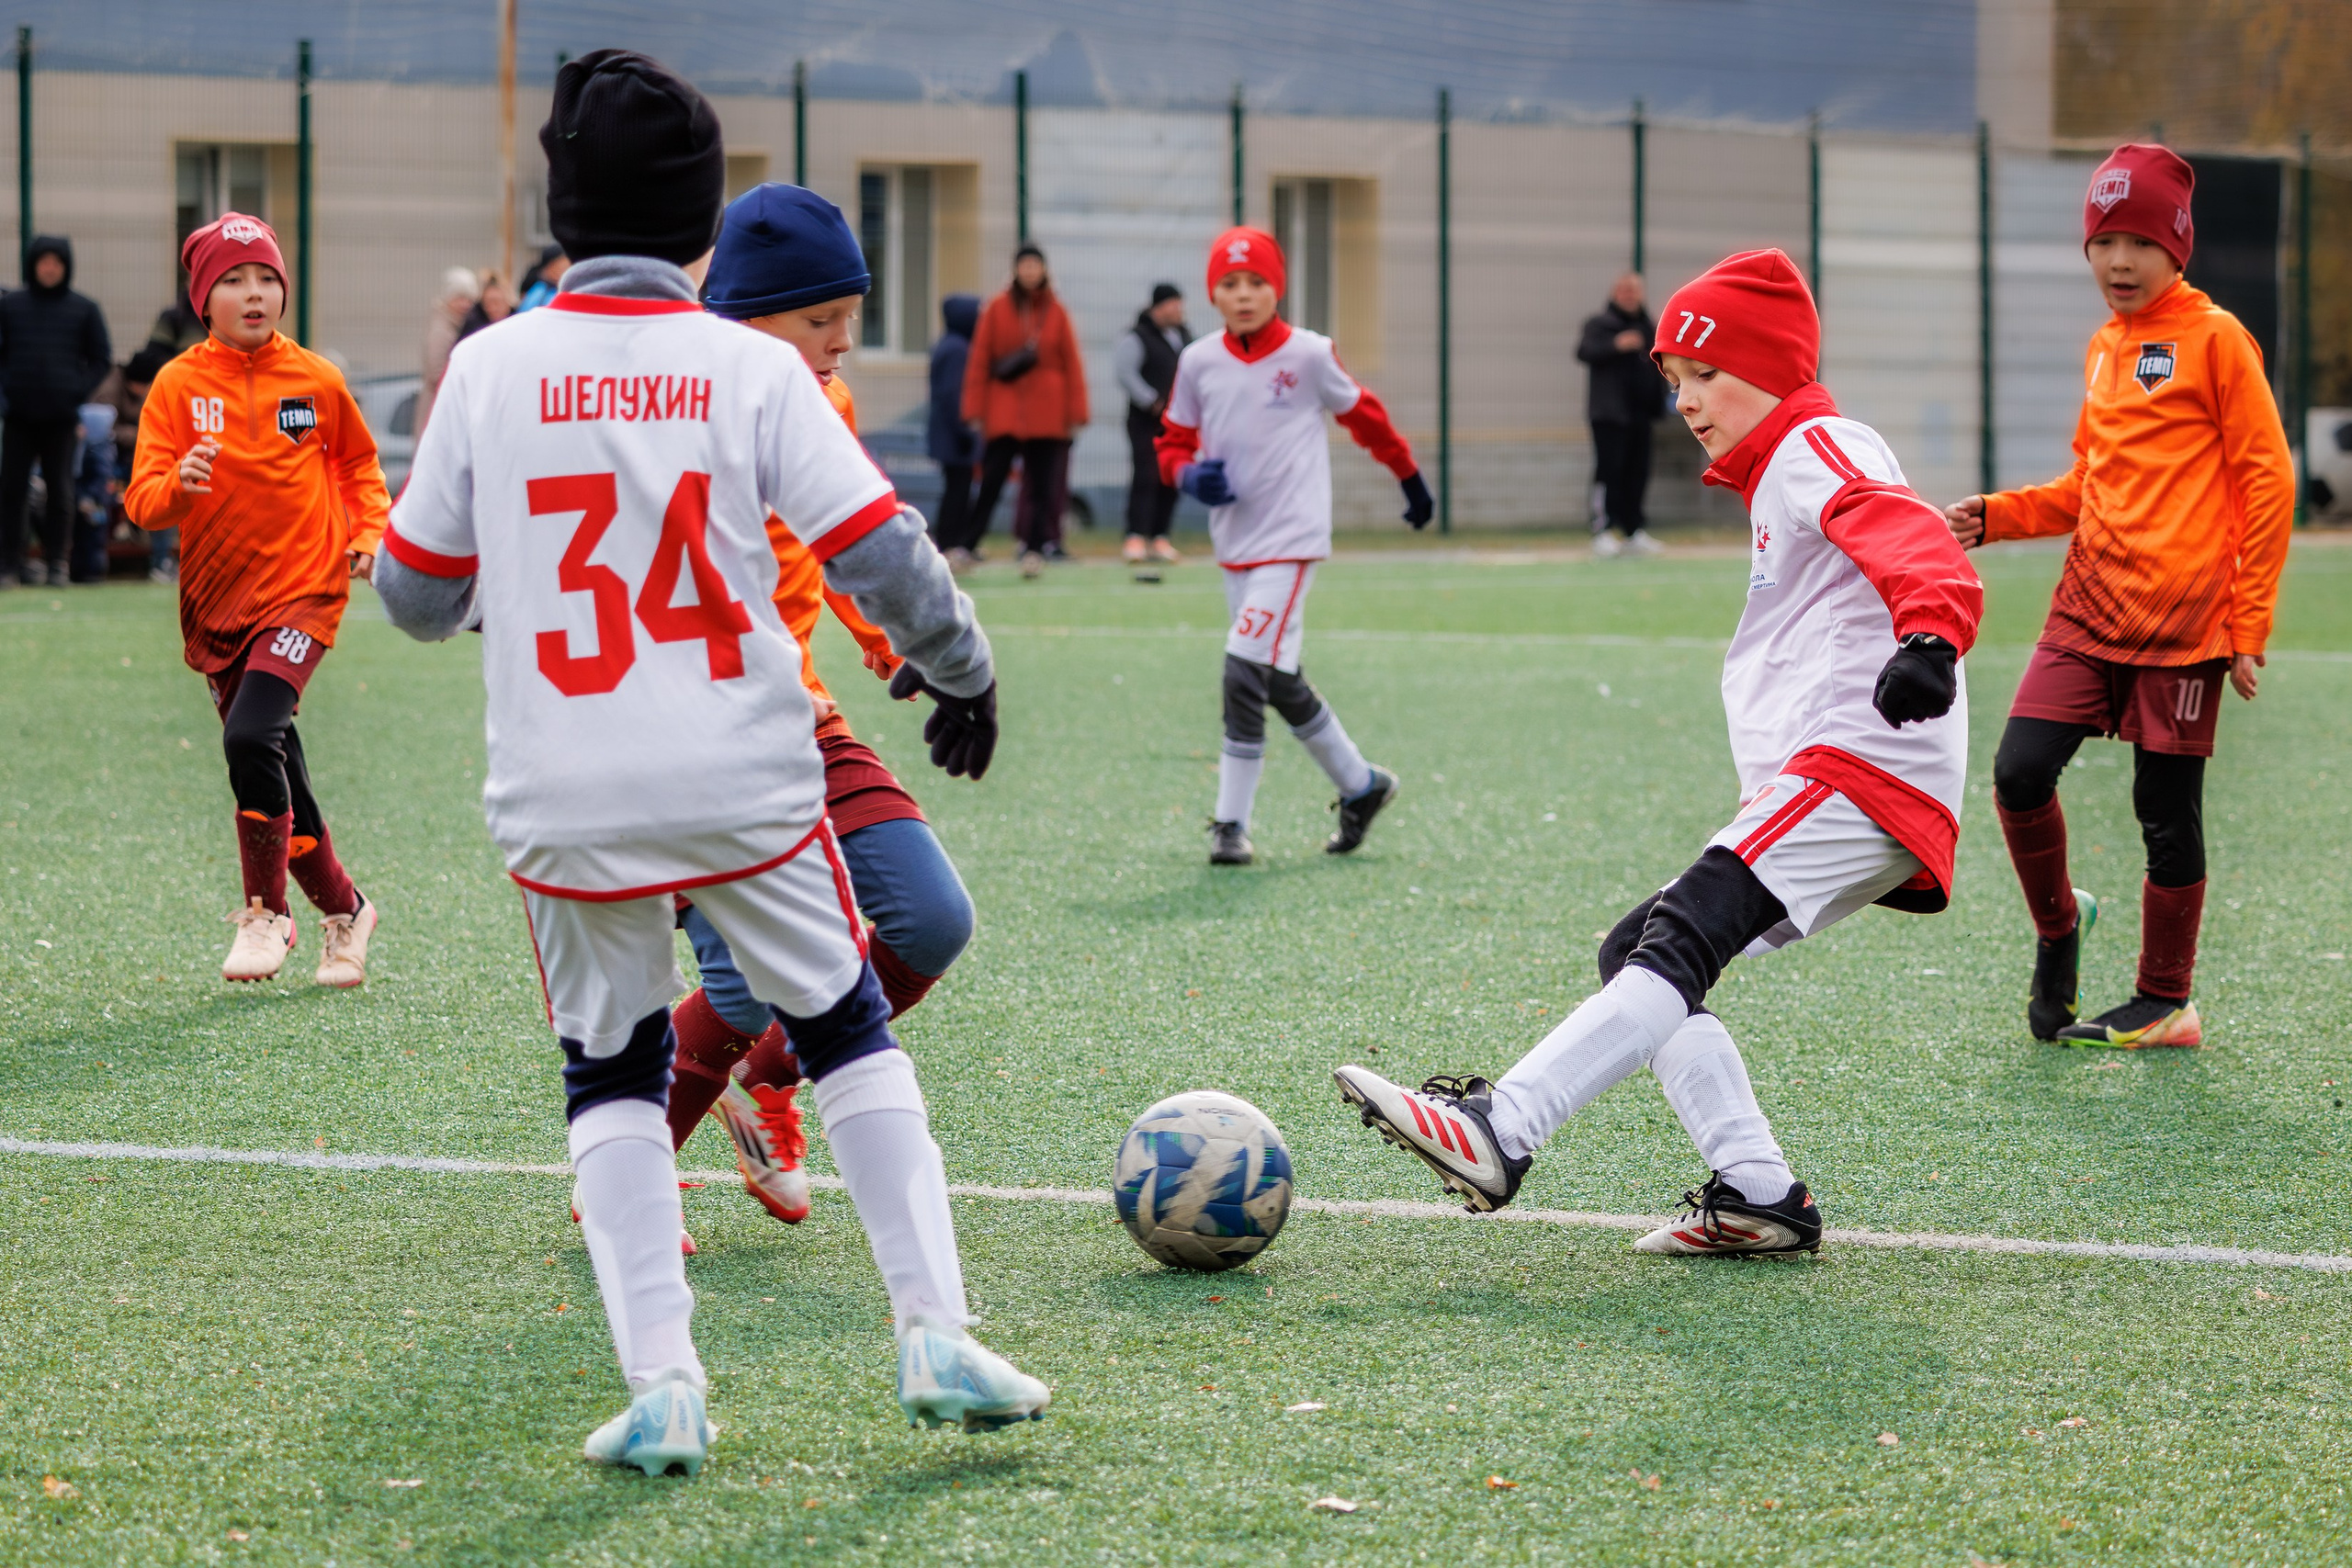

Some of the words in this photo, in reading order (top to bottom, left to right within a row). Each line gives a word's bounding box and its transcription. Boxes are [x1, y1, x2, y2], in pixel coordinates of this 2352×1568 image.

[2174, 208, 2188, 235] 10
[1675, 310, 1716, 349] 77
[2139, 356, 2172, 377] ТЕМП
[191, 396, 224, 433] 98
[540, 375, 712, 423] ШЕЛУХИН
[280, 409, 313, 429] ТЕМП
[526, 470, 753, 697] 34
[1238, 607, 1274, 639] 57
[269, 626, 312, 665] 98
[2176, 678, 2205, 721] 10
